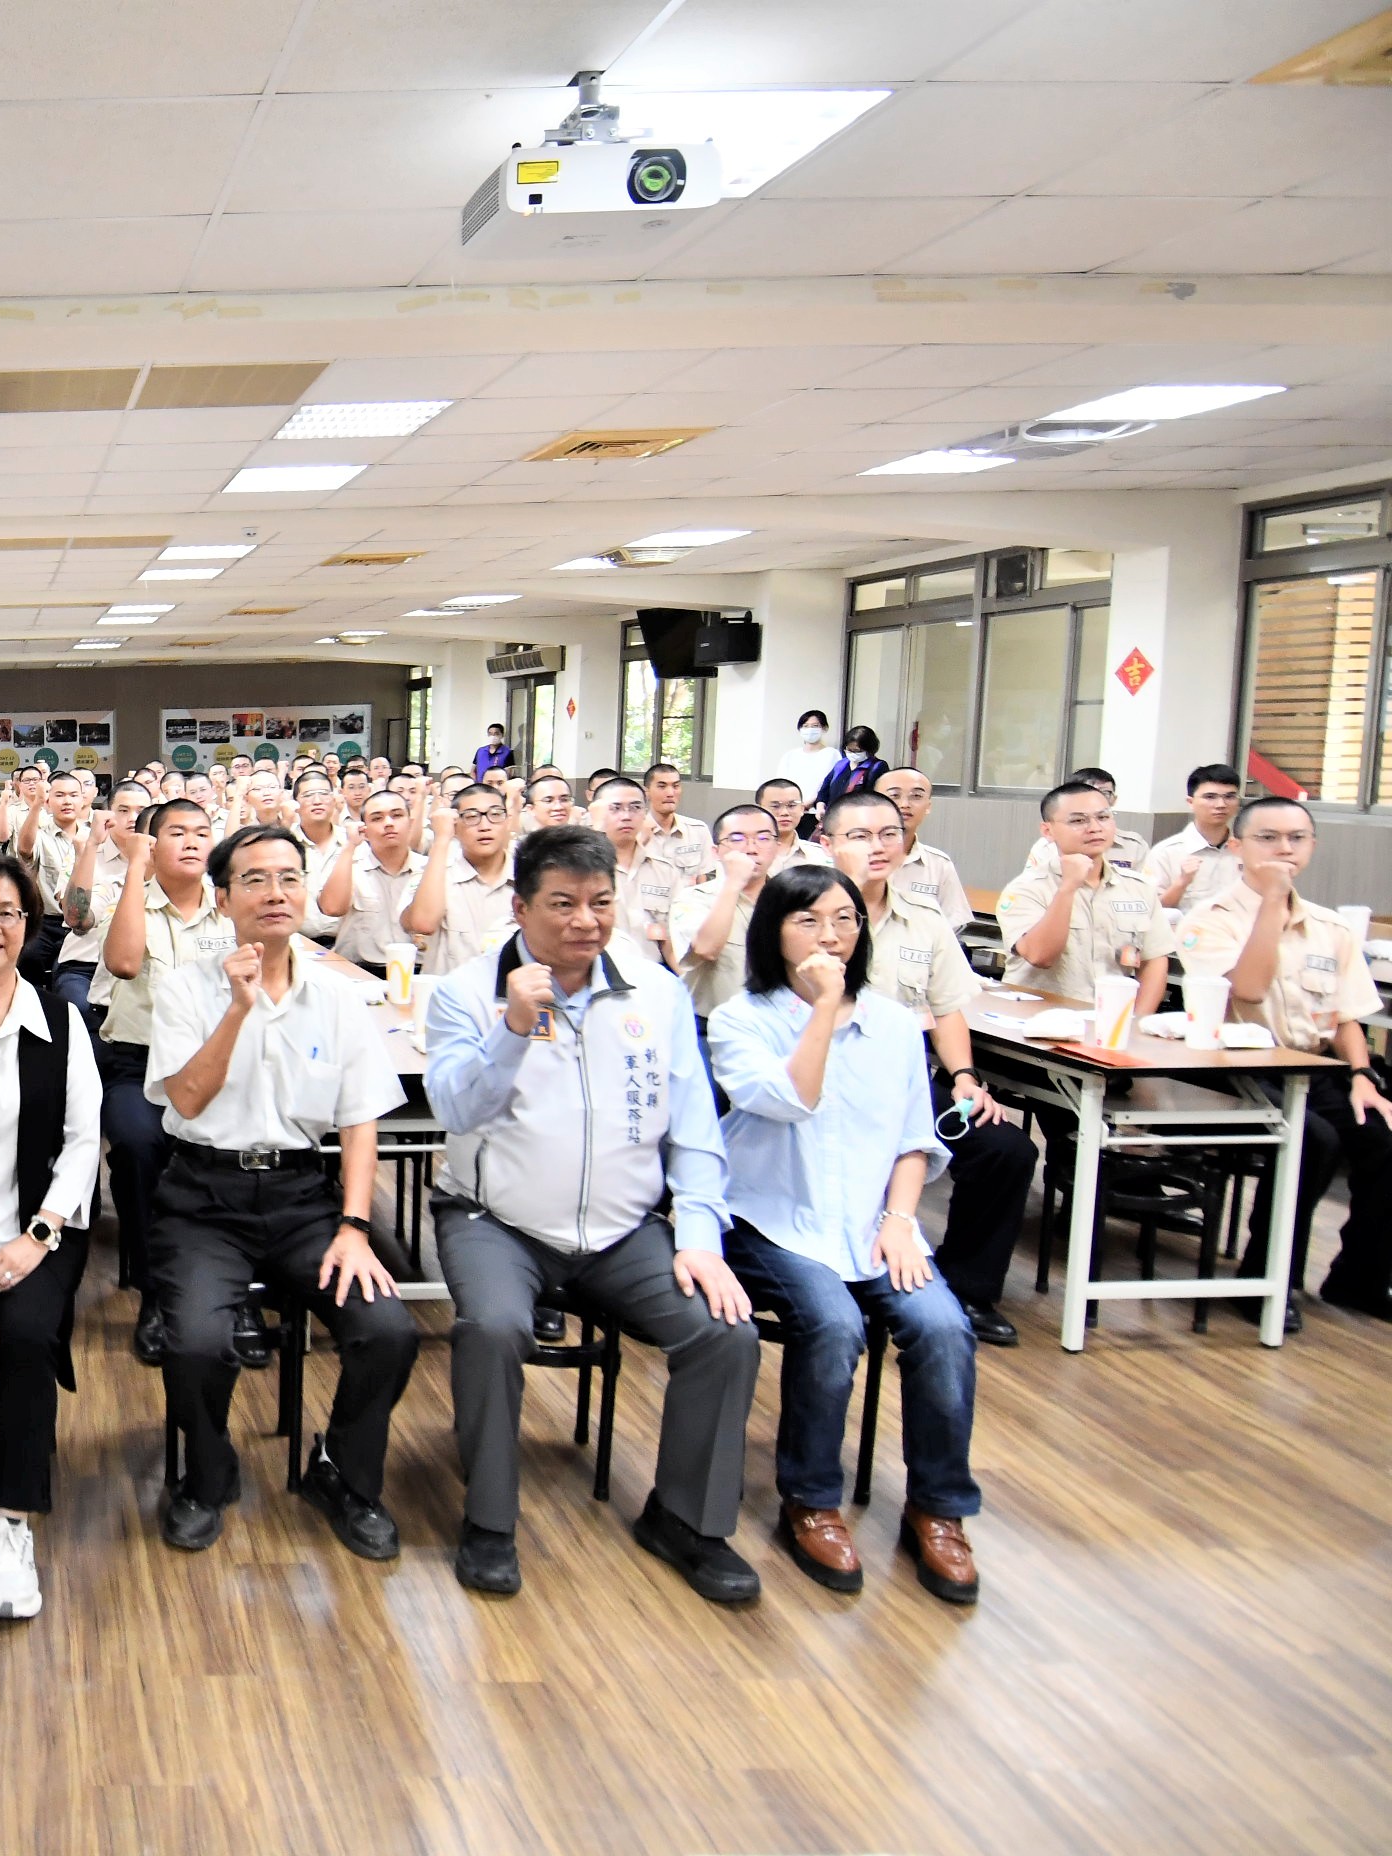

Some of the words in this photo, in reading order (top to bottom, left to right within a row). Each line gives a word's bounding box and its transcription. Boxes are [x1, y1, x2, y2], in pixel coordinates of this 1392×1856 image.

[1124, 657, 1145, 687] 吉
[624, 1055, 644, 1144] 軍人服務站
[644, 1048, 661, 1109] 彰化縣
